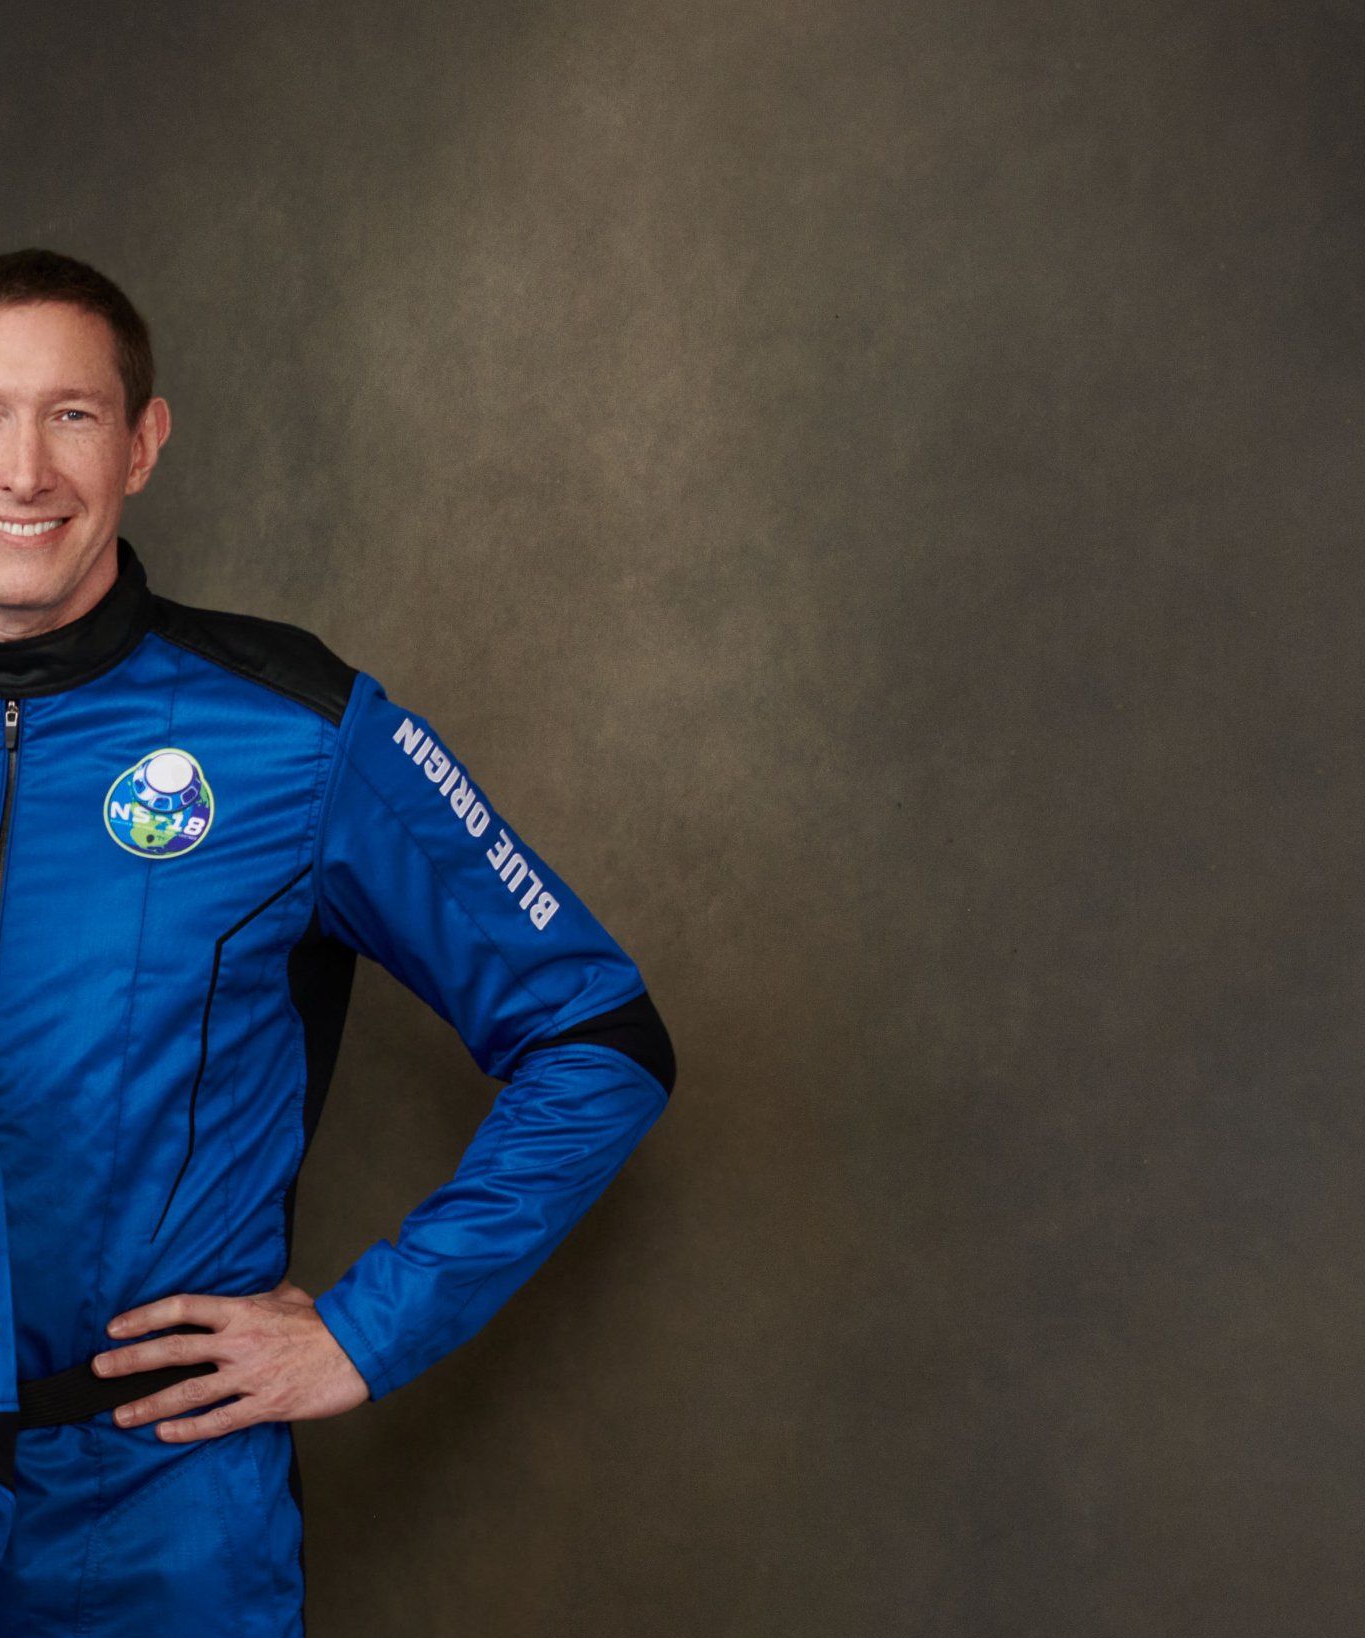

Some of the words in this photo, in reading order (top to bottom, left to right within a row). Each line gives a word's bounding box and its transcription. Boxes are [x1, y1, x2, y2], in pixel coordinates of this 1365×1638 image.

[110, 801, 206, 836] NS-18
[392, 717, 491, 838] ORIGIN
[486, 828, 560, 931] BLUE
